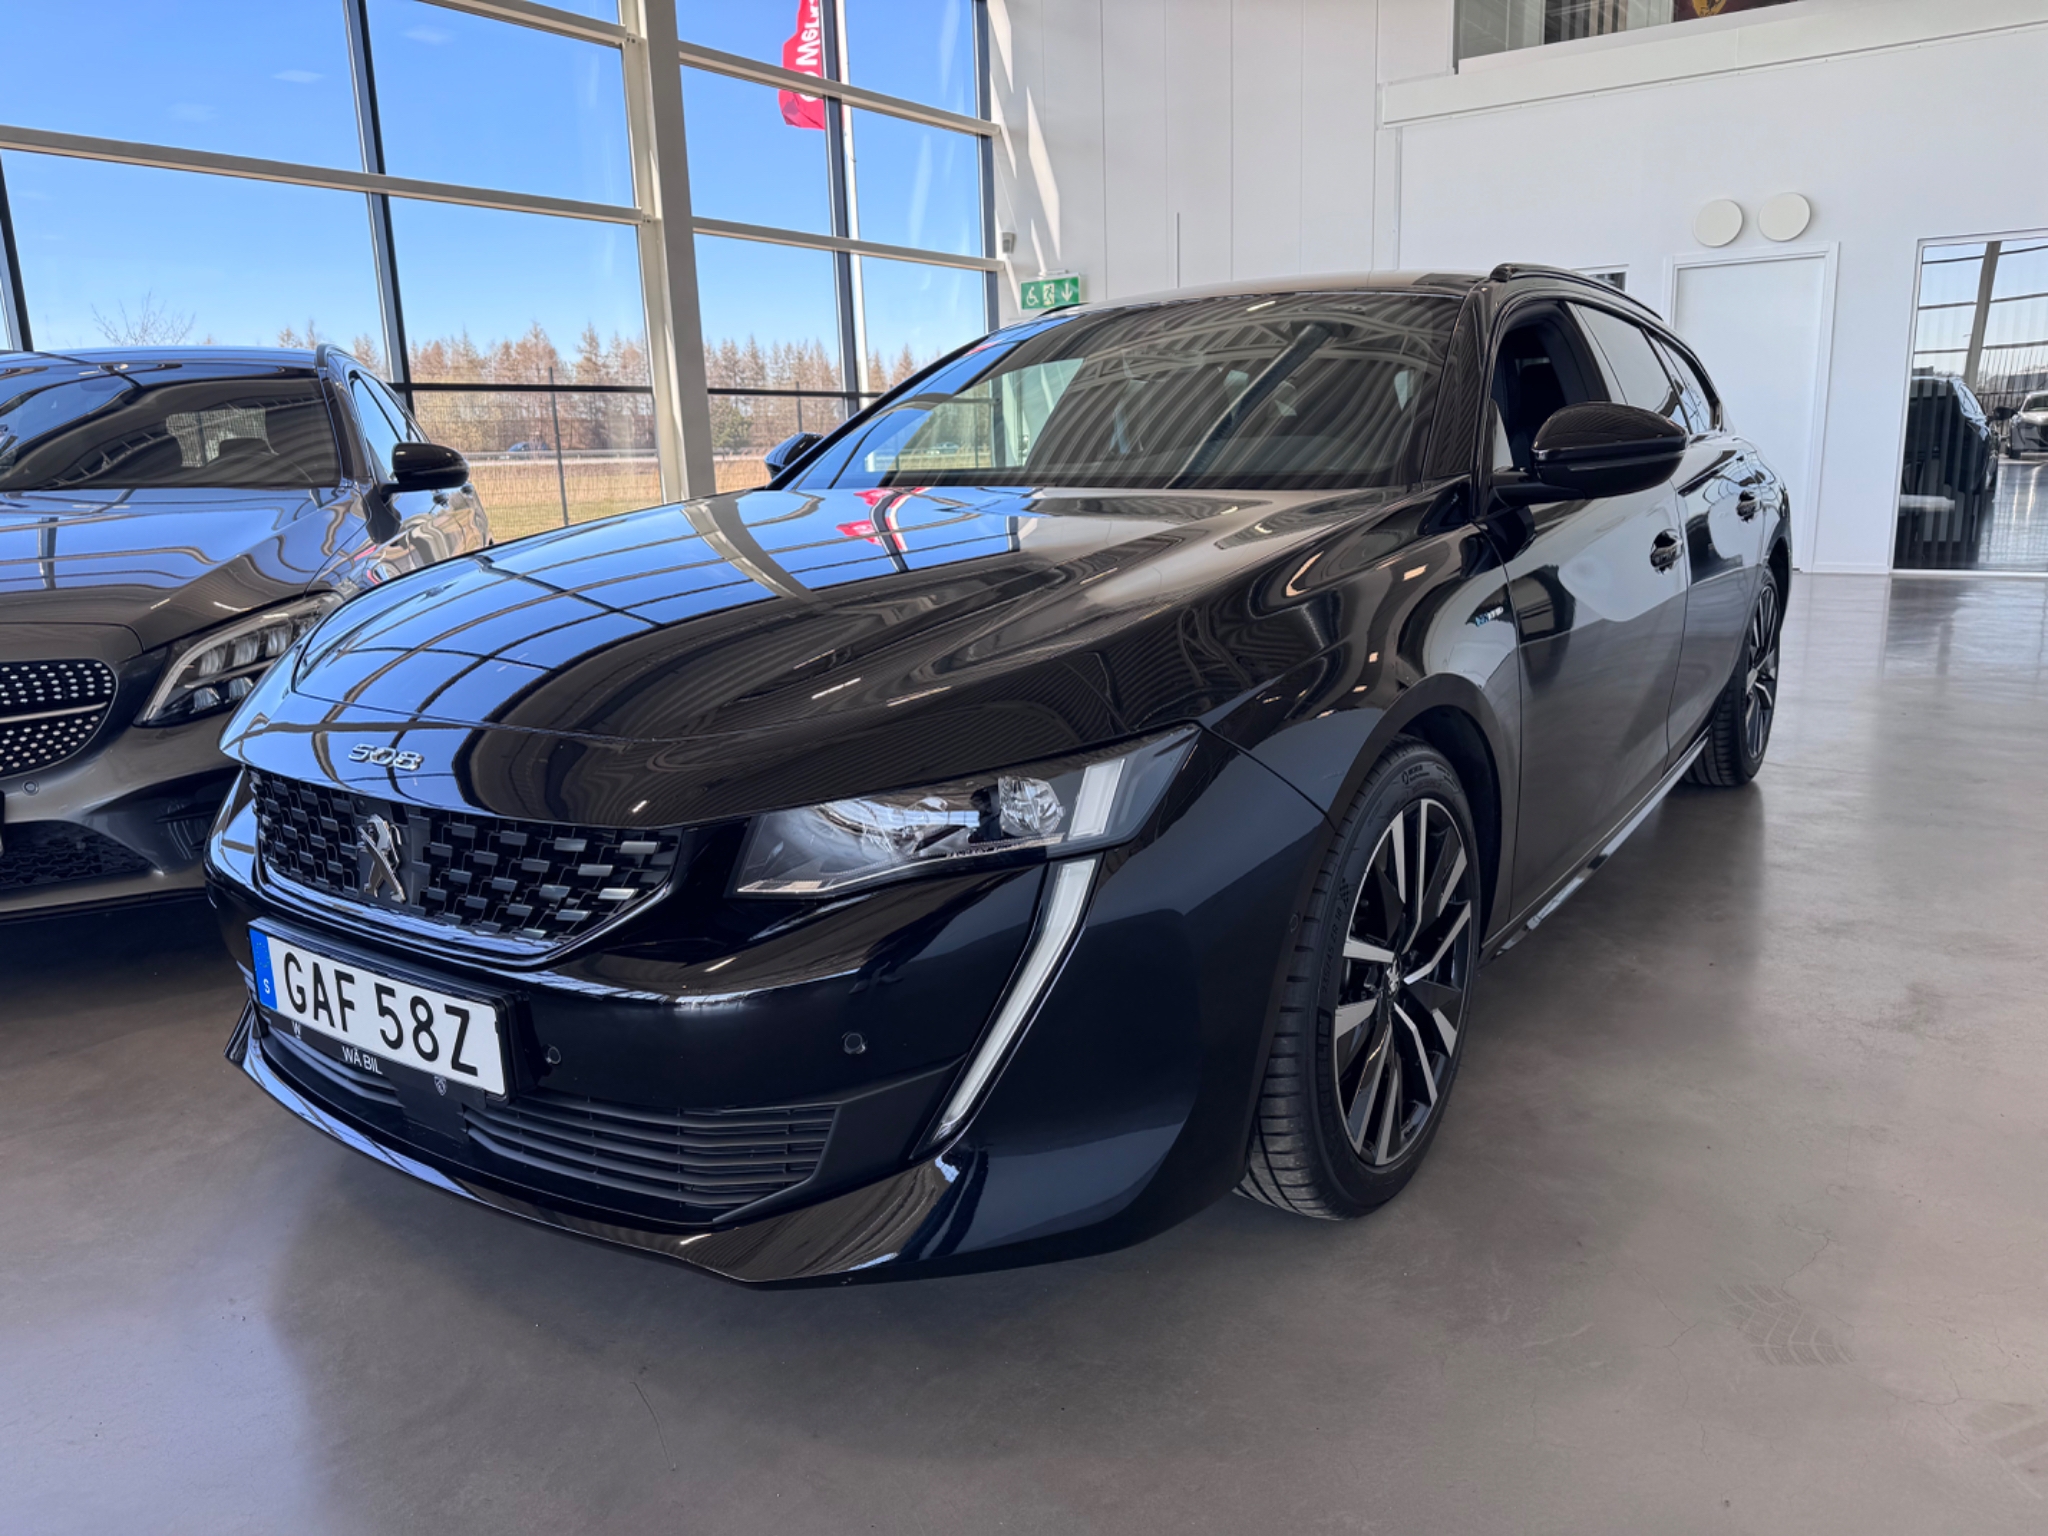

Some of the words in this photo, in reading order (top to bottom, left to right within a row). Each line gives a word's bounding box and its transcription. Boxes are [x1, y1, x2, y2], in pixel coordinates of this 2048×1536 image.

[348, 743, 424, 771] 508
[263, 978, 271, 994] S
[283, 951, 356, 1033] GAF
[374, 982, 478, 1077] 58Z
[362, 1053, 383, 1075] BIL
